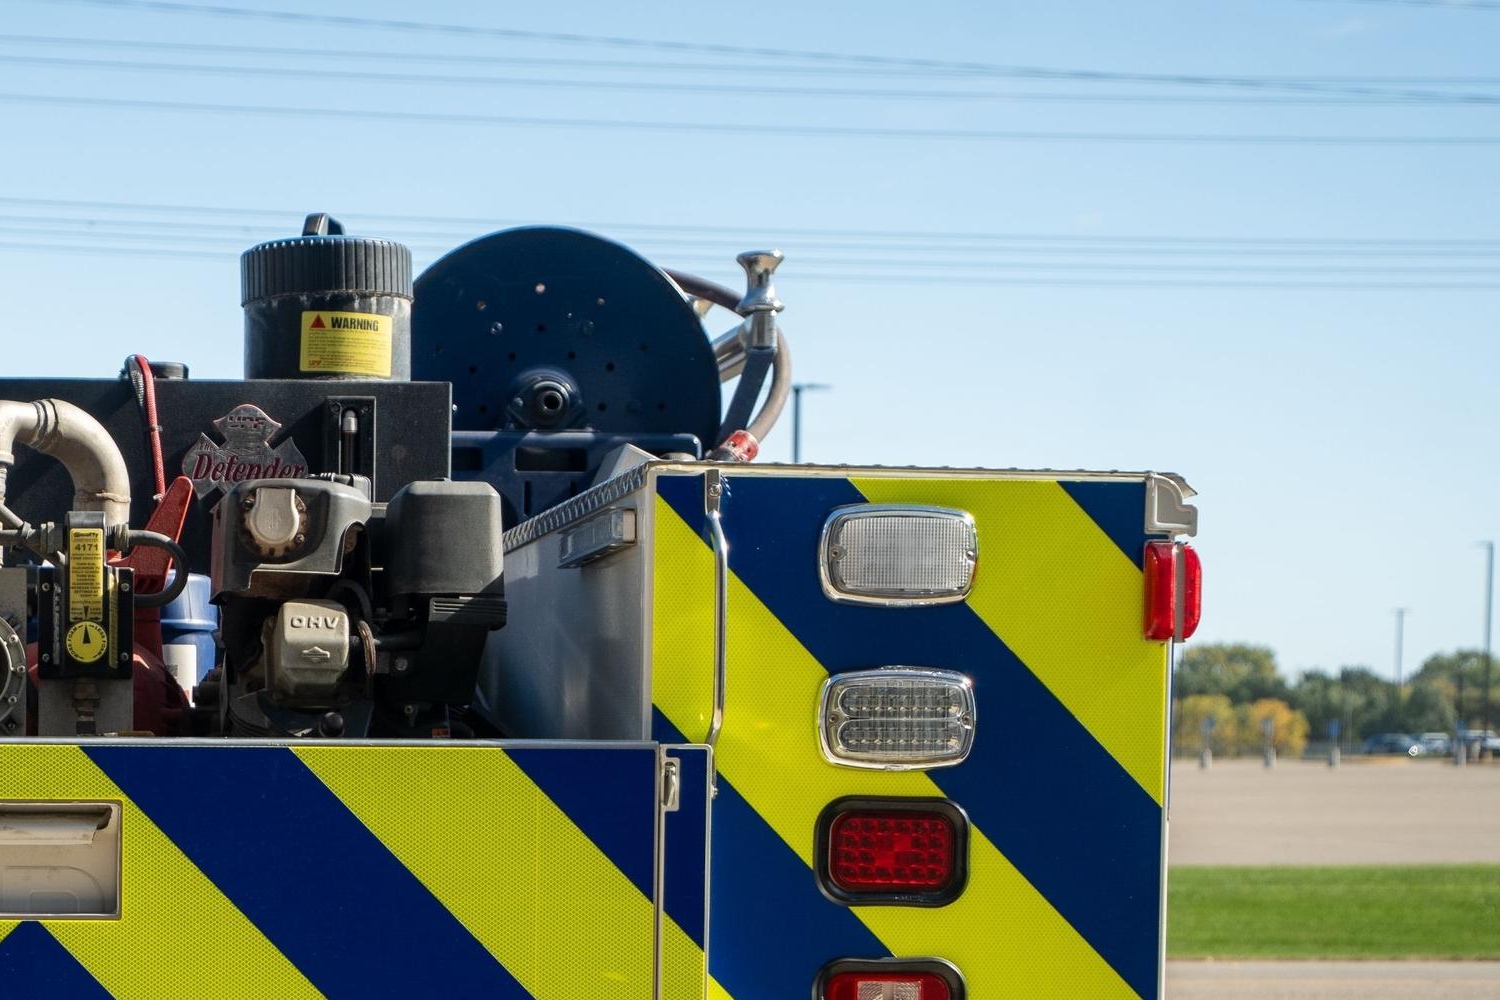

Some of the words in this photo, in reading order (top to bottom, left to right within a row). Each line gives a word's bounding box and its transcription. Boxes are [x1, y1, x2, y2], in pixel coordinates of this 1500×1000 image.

[331, 317, 379, 331] WARNING
[193, 454, 305, 482] Defender
[74, 543, 99, 551] 4171
[290, 615, 340, 630] OHV
